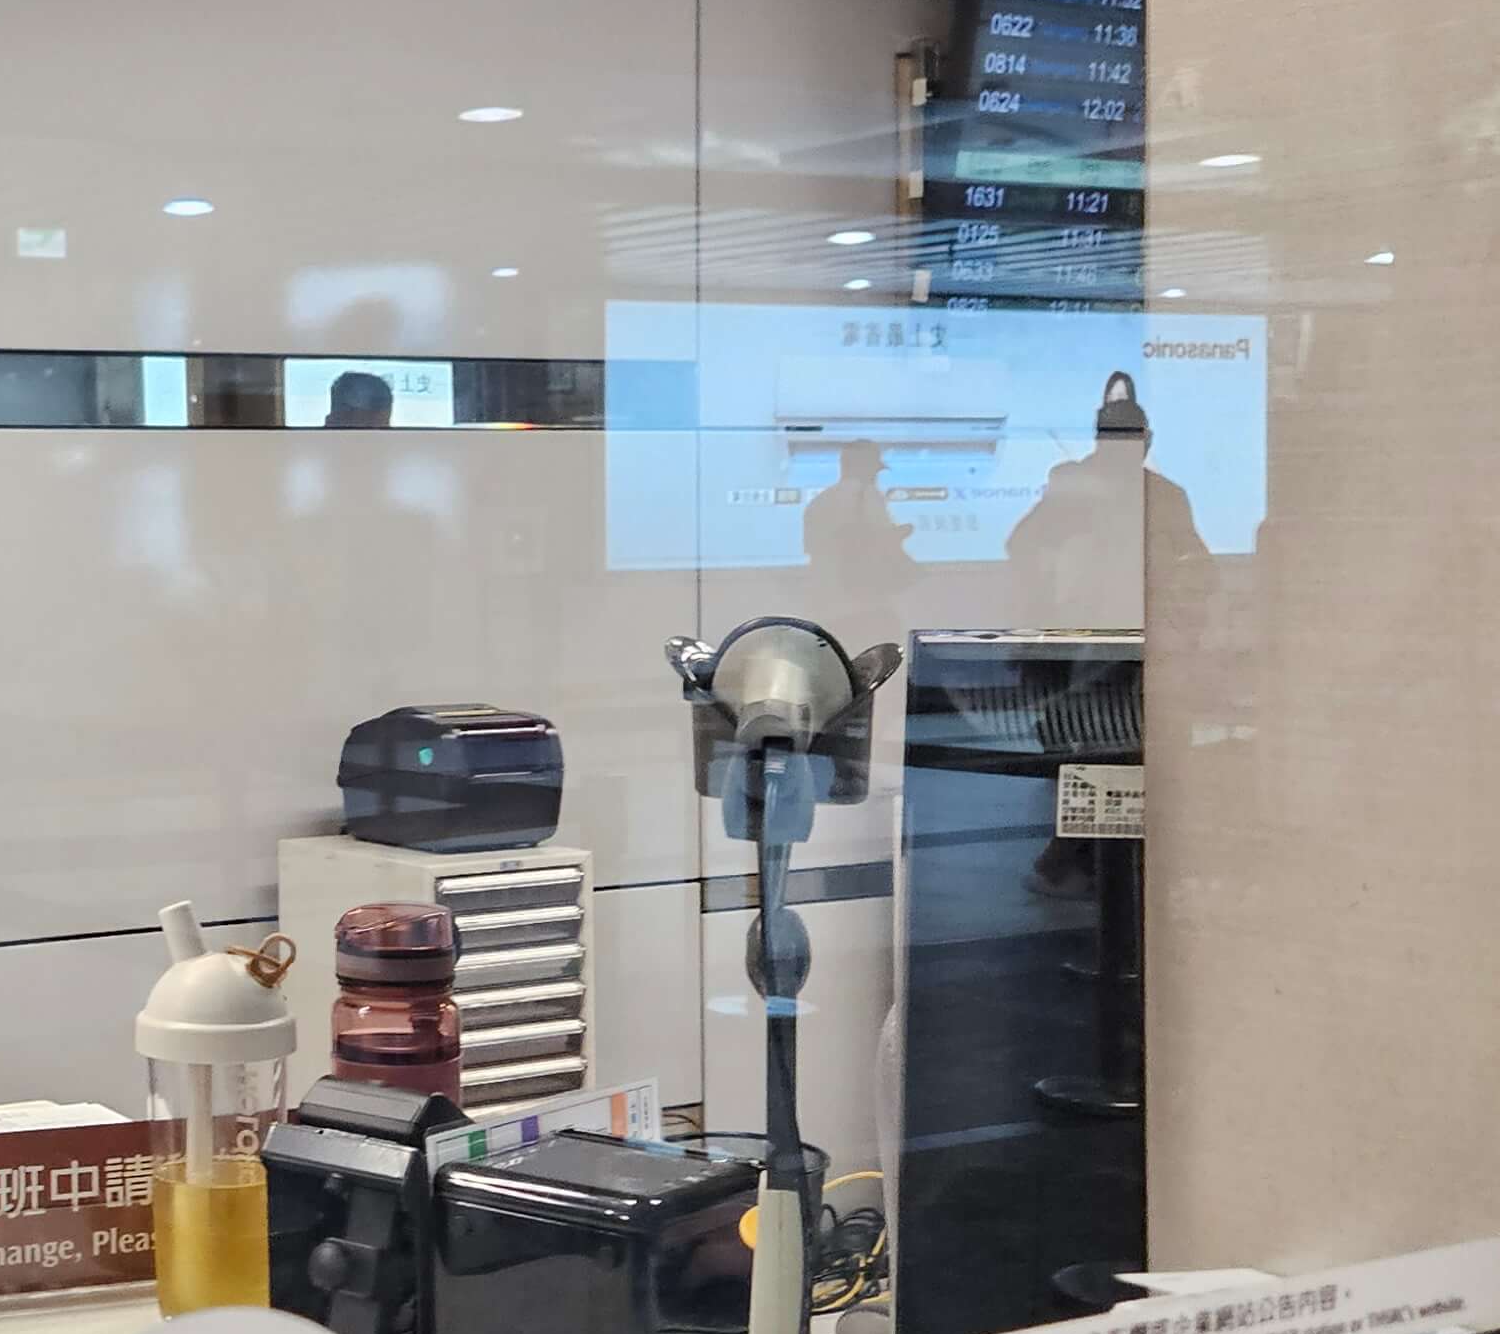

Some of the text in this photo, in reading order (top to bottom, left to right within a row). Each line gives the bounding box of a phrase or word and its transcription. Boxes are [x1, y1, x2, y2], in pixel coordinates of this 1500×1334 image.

[1088, 61, 1133, 84] 11:42
[1081, 99, 1126, 122] 12:02
[964, 186, 1109, 213] 1631 11:21
[92, 1226, 157, 1256] Plea
